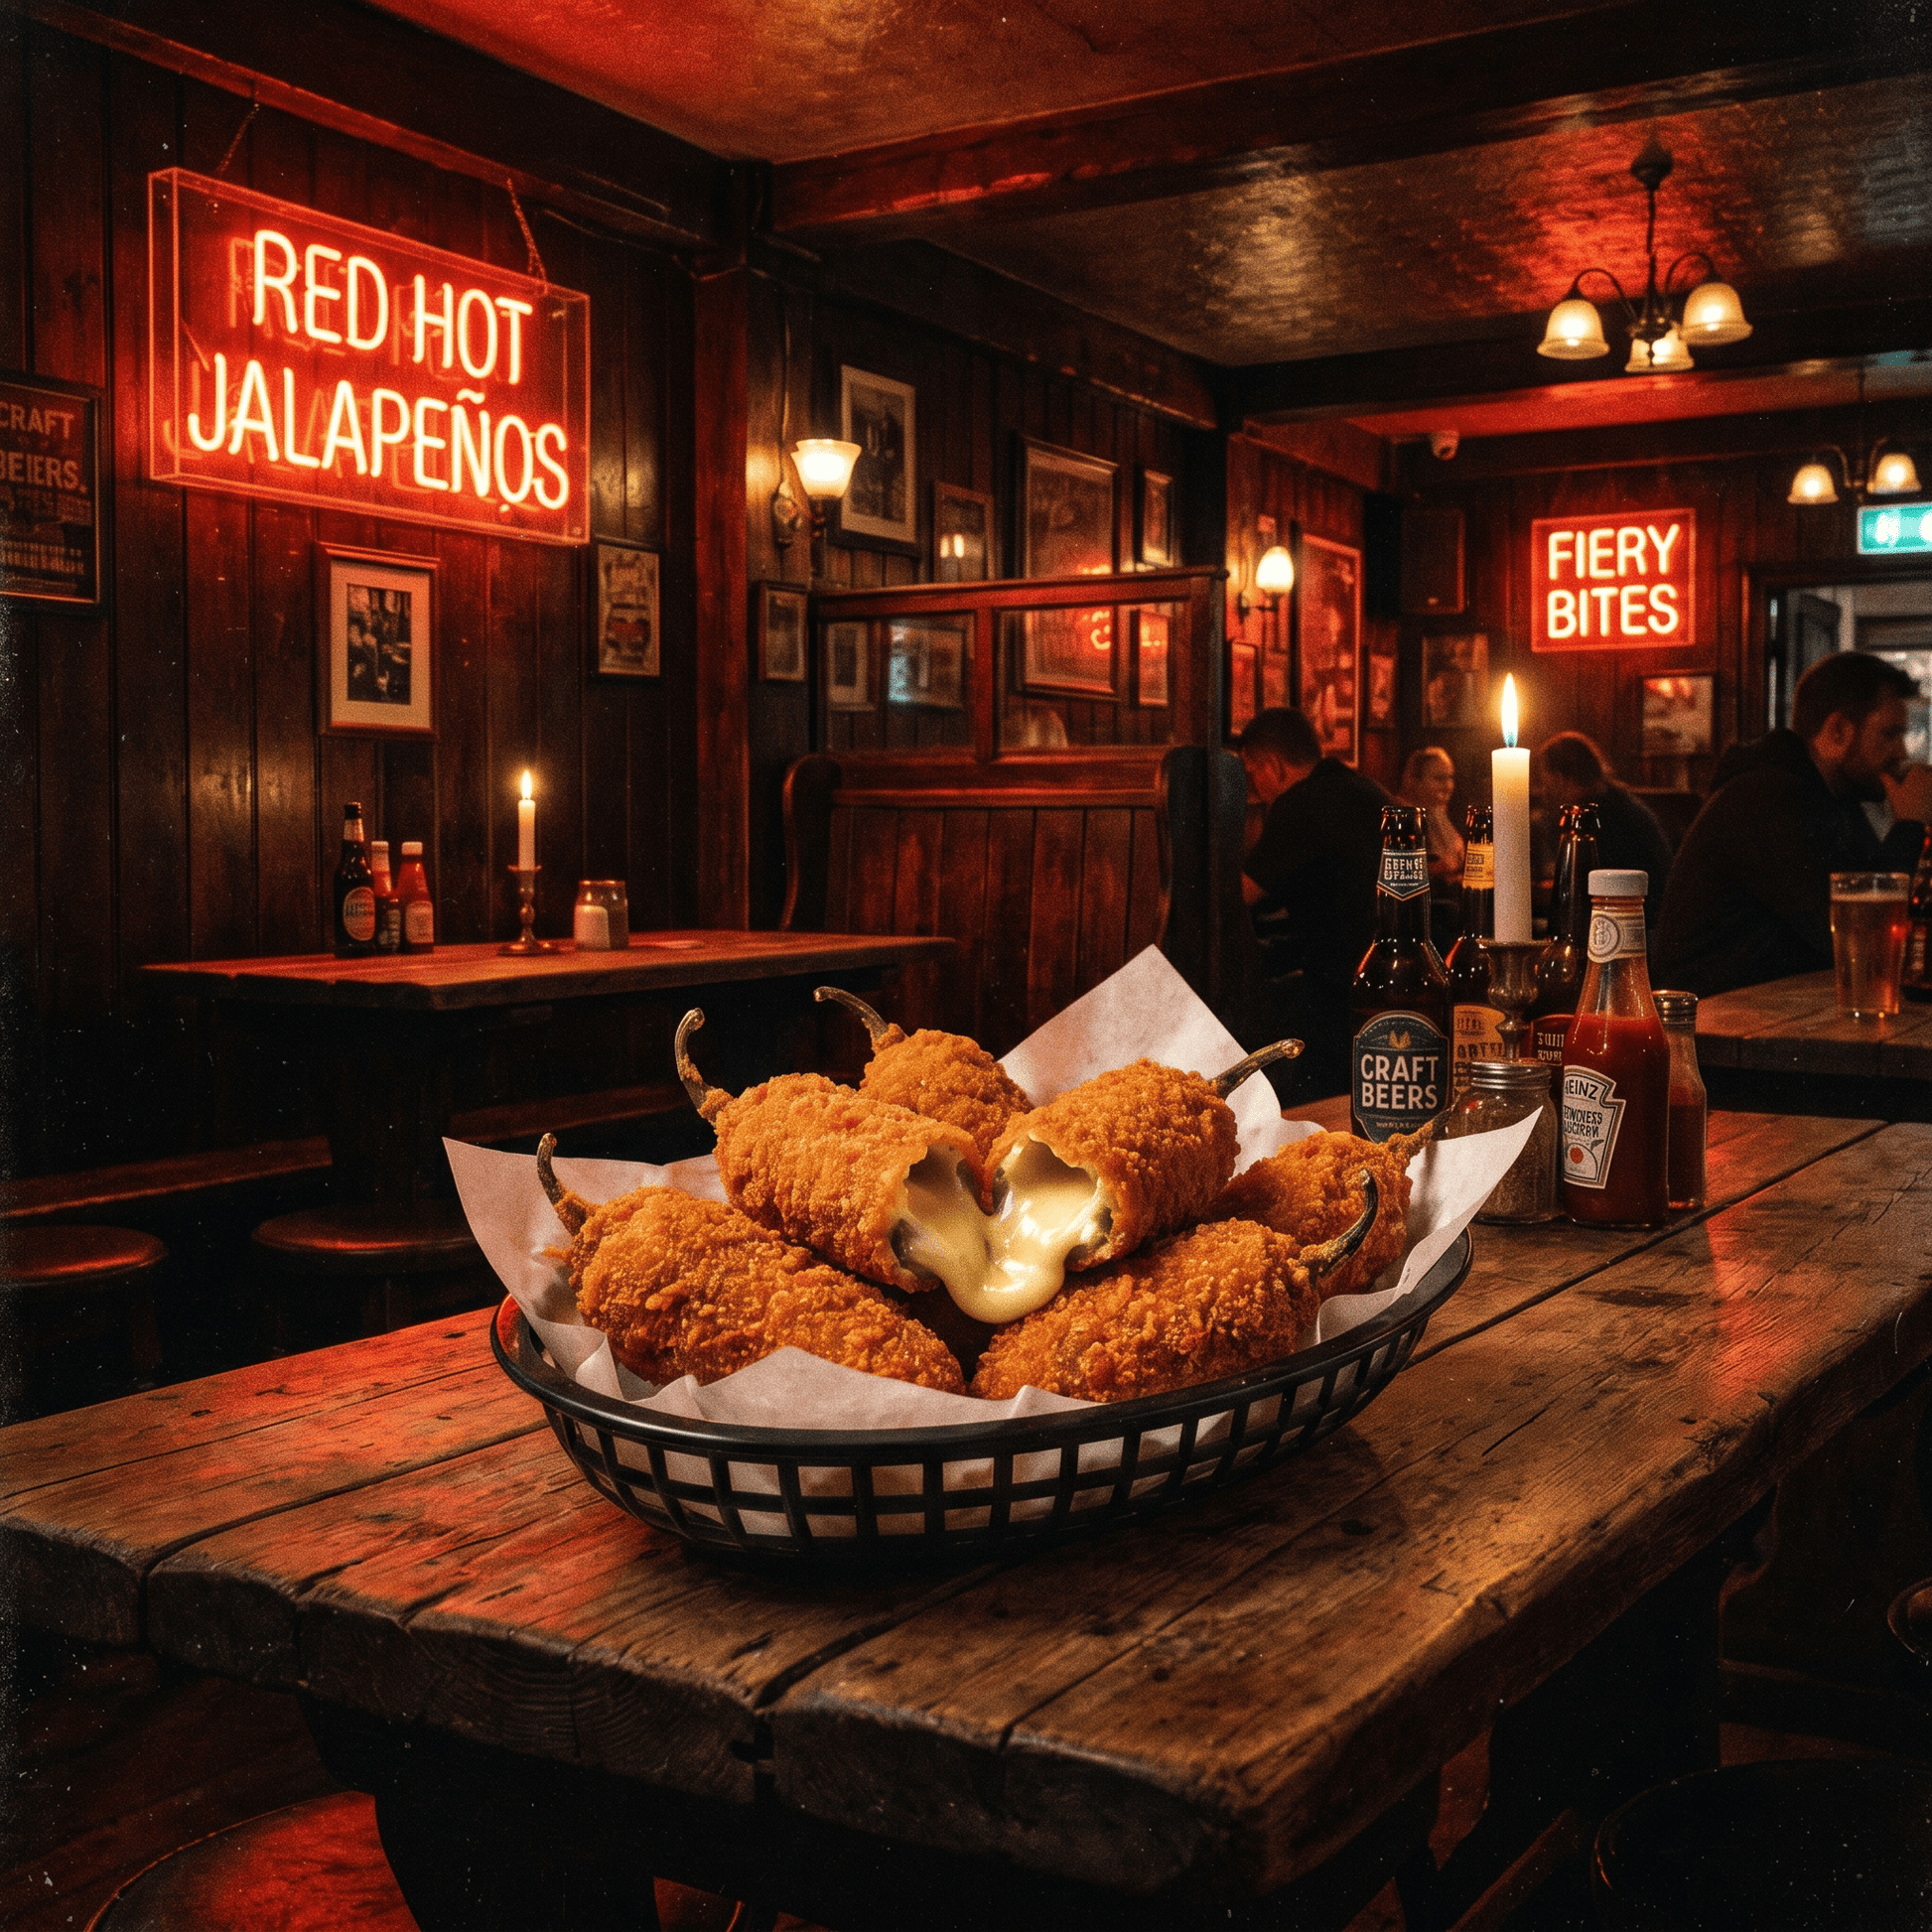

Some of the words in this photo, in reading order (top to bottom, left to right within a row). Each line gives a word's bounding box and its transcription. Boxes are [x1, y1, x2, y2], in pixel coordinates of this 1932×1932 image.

[253, 230, 388, 350] RED
[413, 275, 532, 384] HOT
[189, 353, 570, 510] JALAPEÑOS
[1548, 524, 1680, 580] FIERY
[1547, 584, 1679, 638] BITES
[1360, 1053, 1439, 1082] CRAFT
[1361, 1081, 1438, 1110] BEERS
